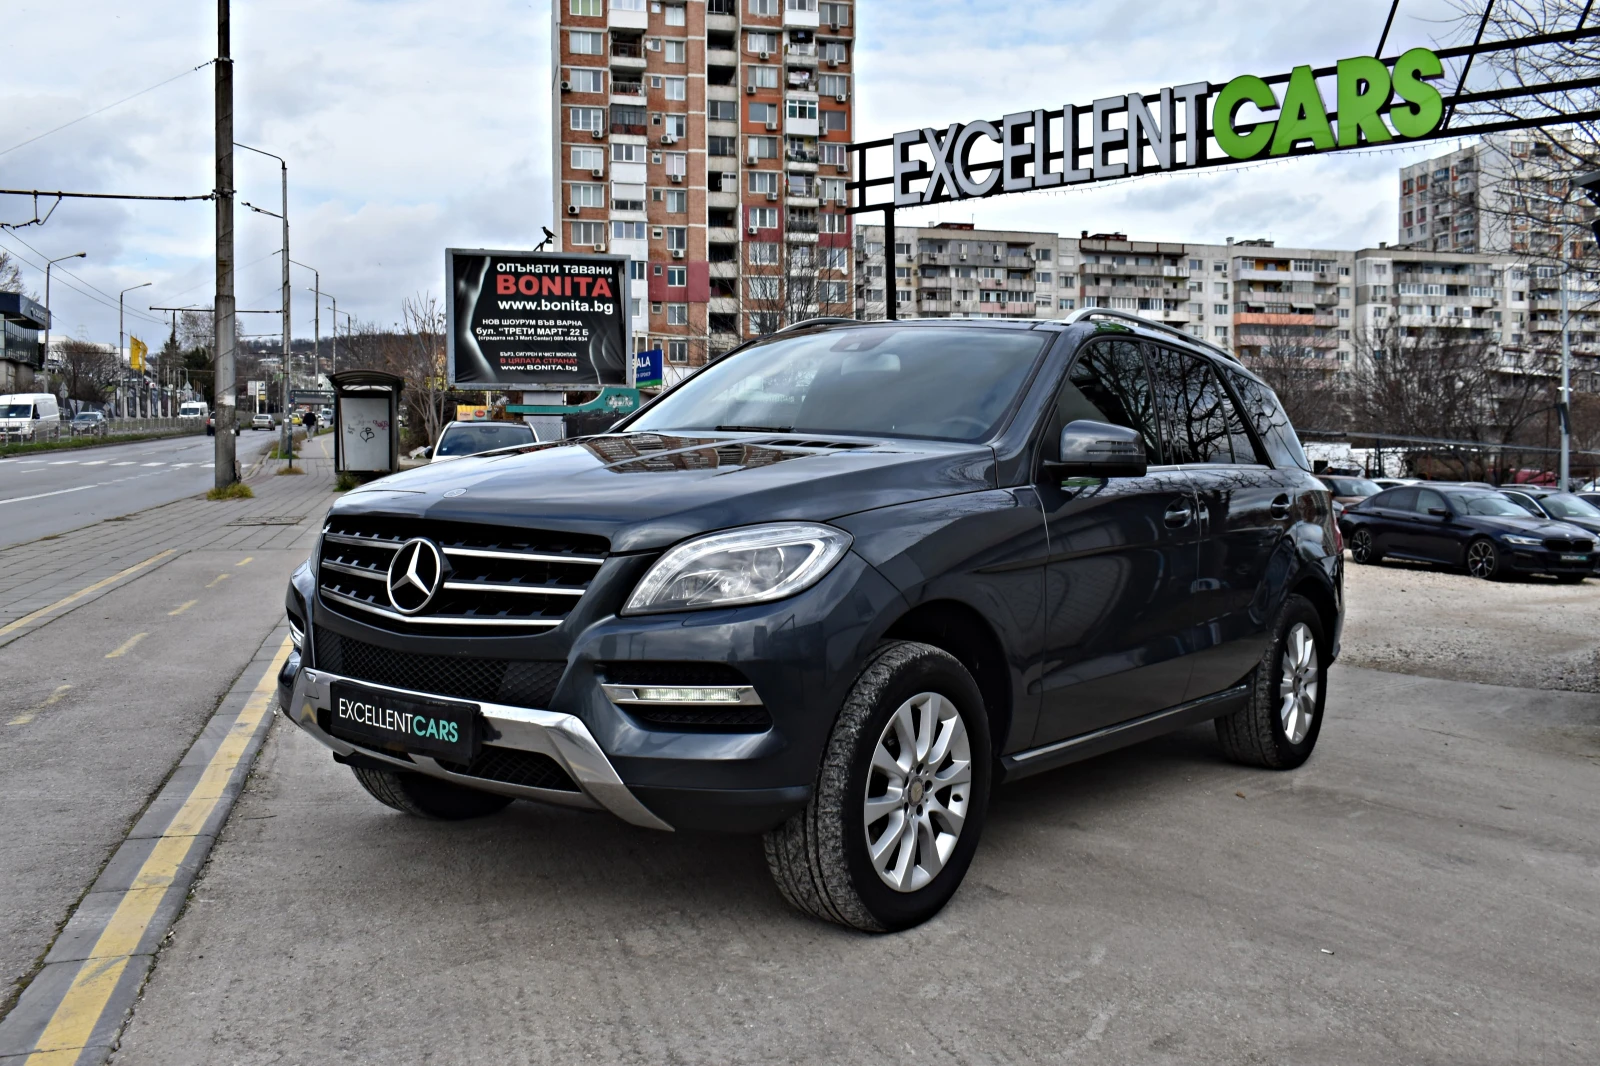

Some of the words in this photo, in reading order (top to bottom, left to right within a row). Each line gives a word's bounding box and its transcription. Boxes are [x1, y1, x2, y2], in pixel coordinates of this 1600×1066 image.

[496, 263, 560, 274] опънати
[563, 264, 613, 275] тавани
[496, 274, 613, 298] BONITA
[497, 299, 614, 315] www.bonita.bg
[476, 327, 497, 336] бул.
[569, 328, 580, 336] 22
[582, 328, 589, 336] Б
[338, 697, 459, 743] EXCELLENTCARS
